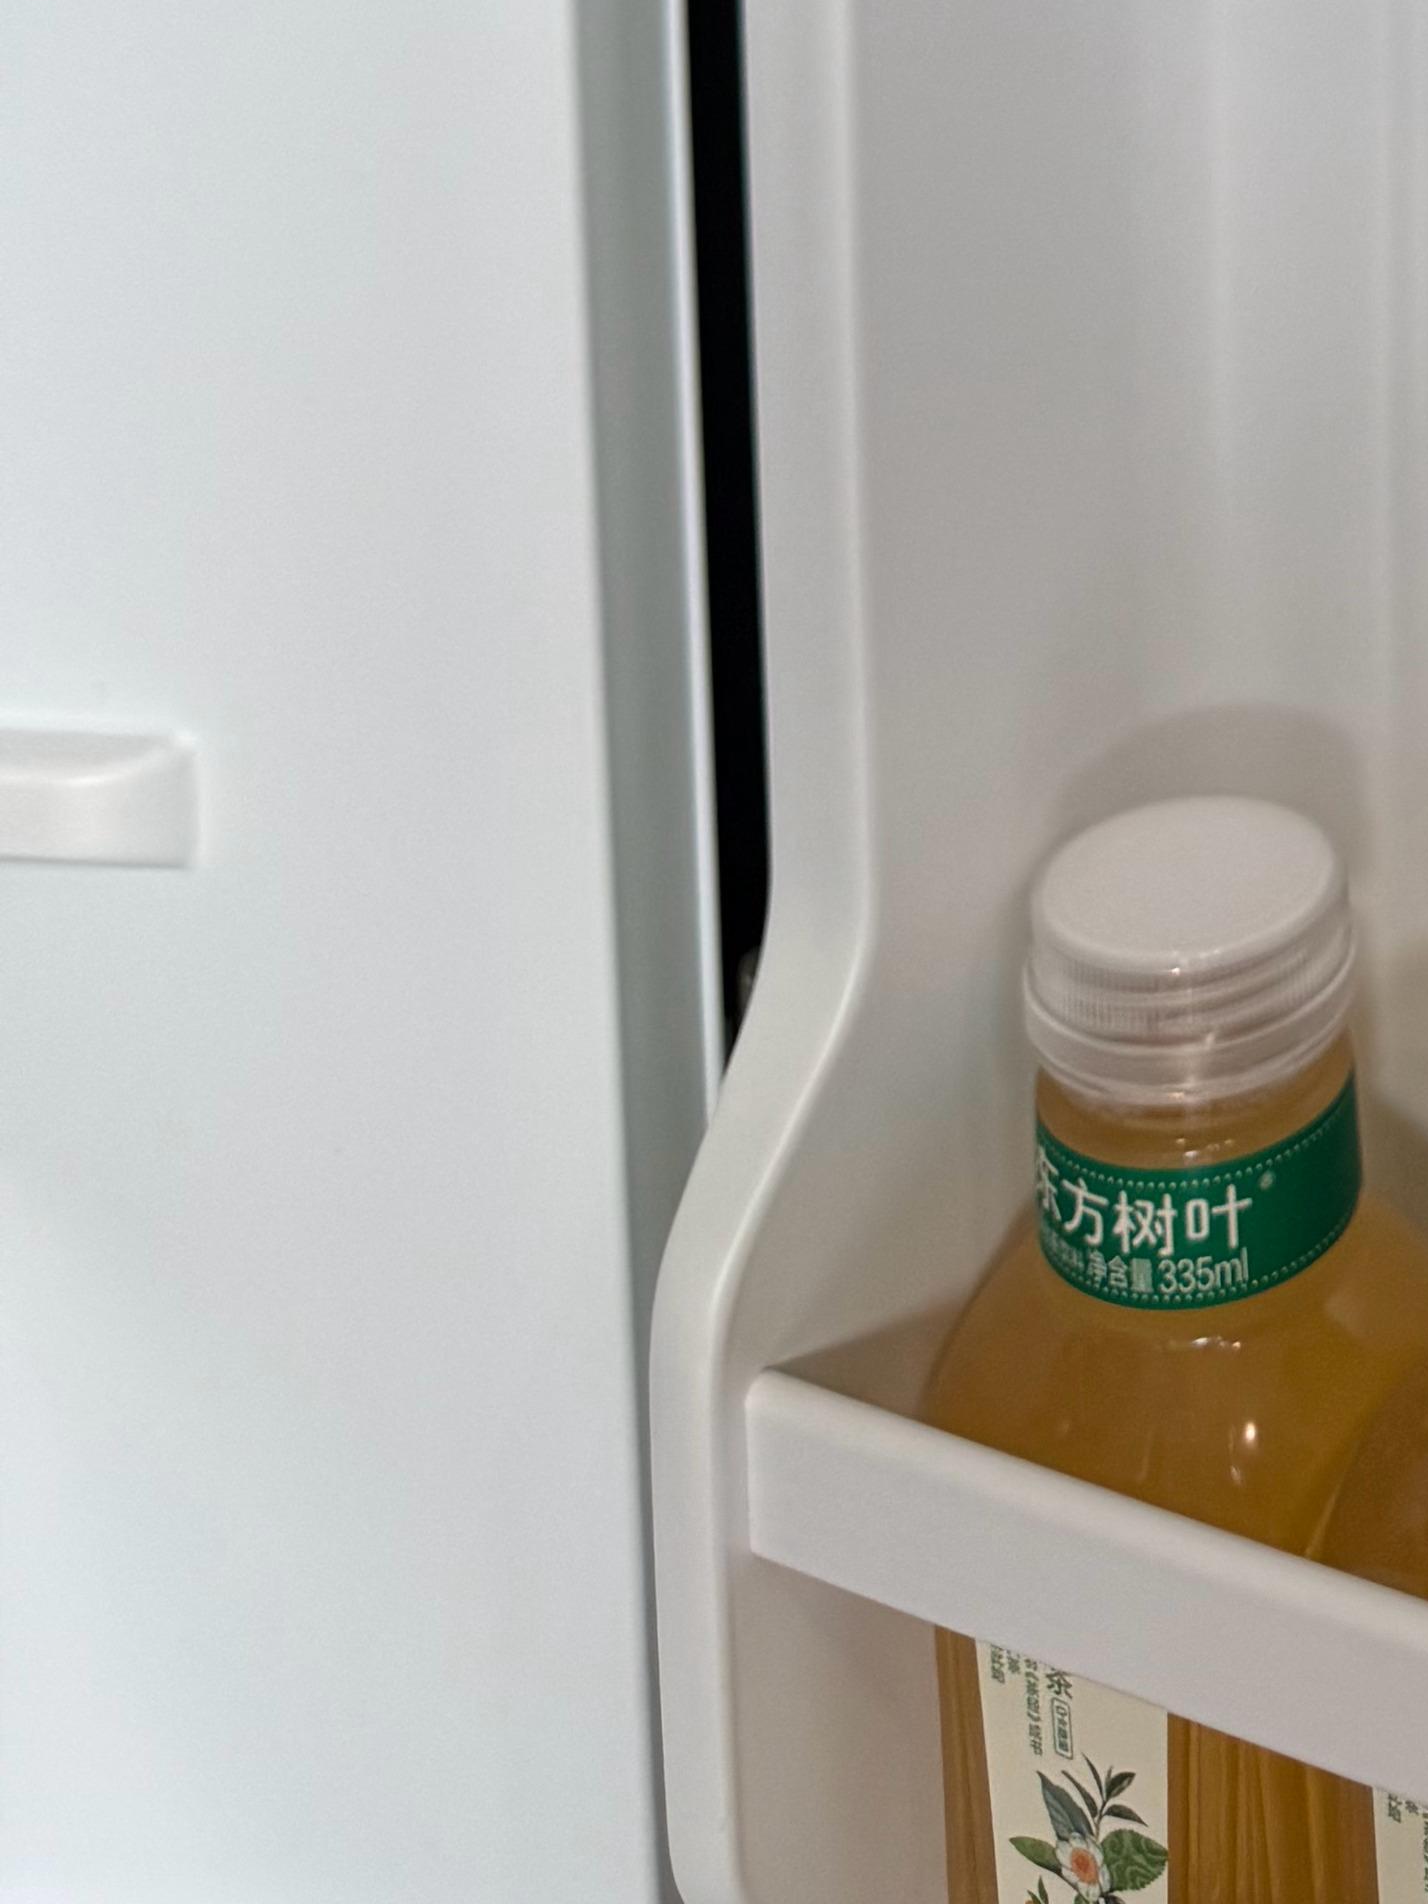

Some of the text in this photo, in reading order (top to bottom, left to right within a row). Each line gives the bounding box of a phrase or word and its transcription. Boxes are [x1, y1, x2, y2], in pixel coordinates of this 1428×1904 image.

[1037, 1145, 1252, 1256] 东方树叶
[1088, 1247, 1249, 1293] 净含量 335ml
